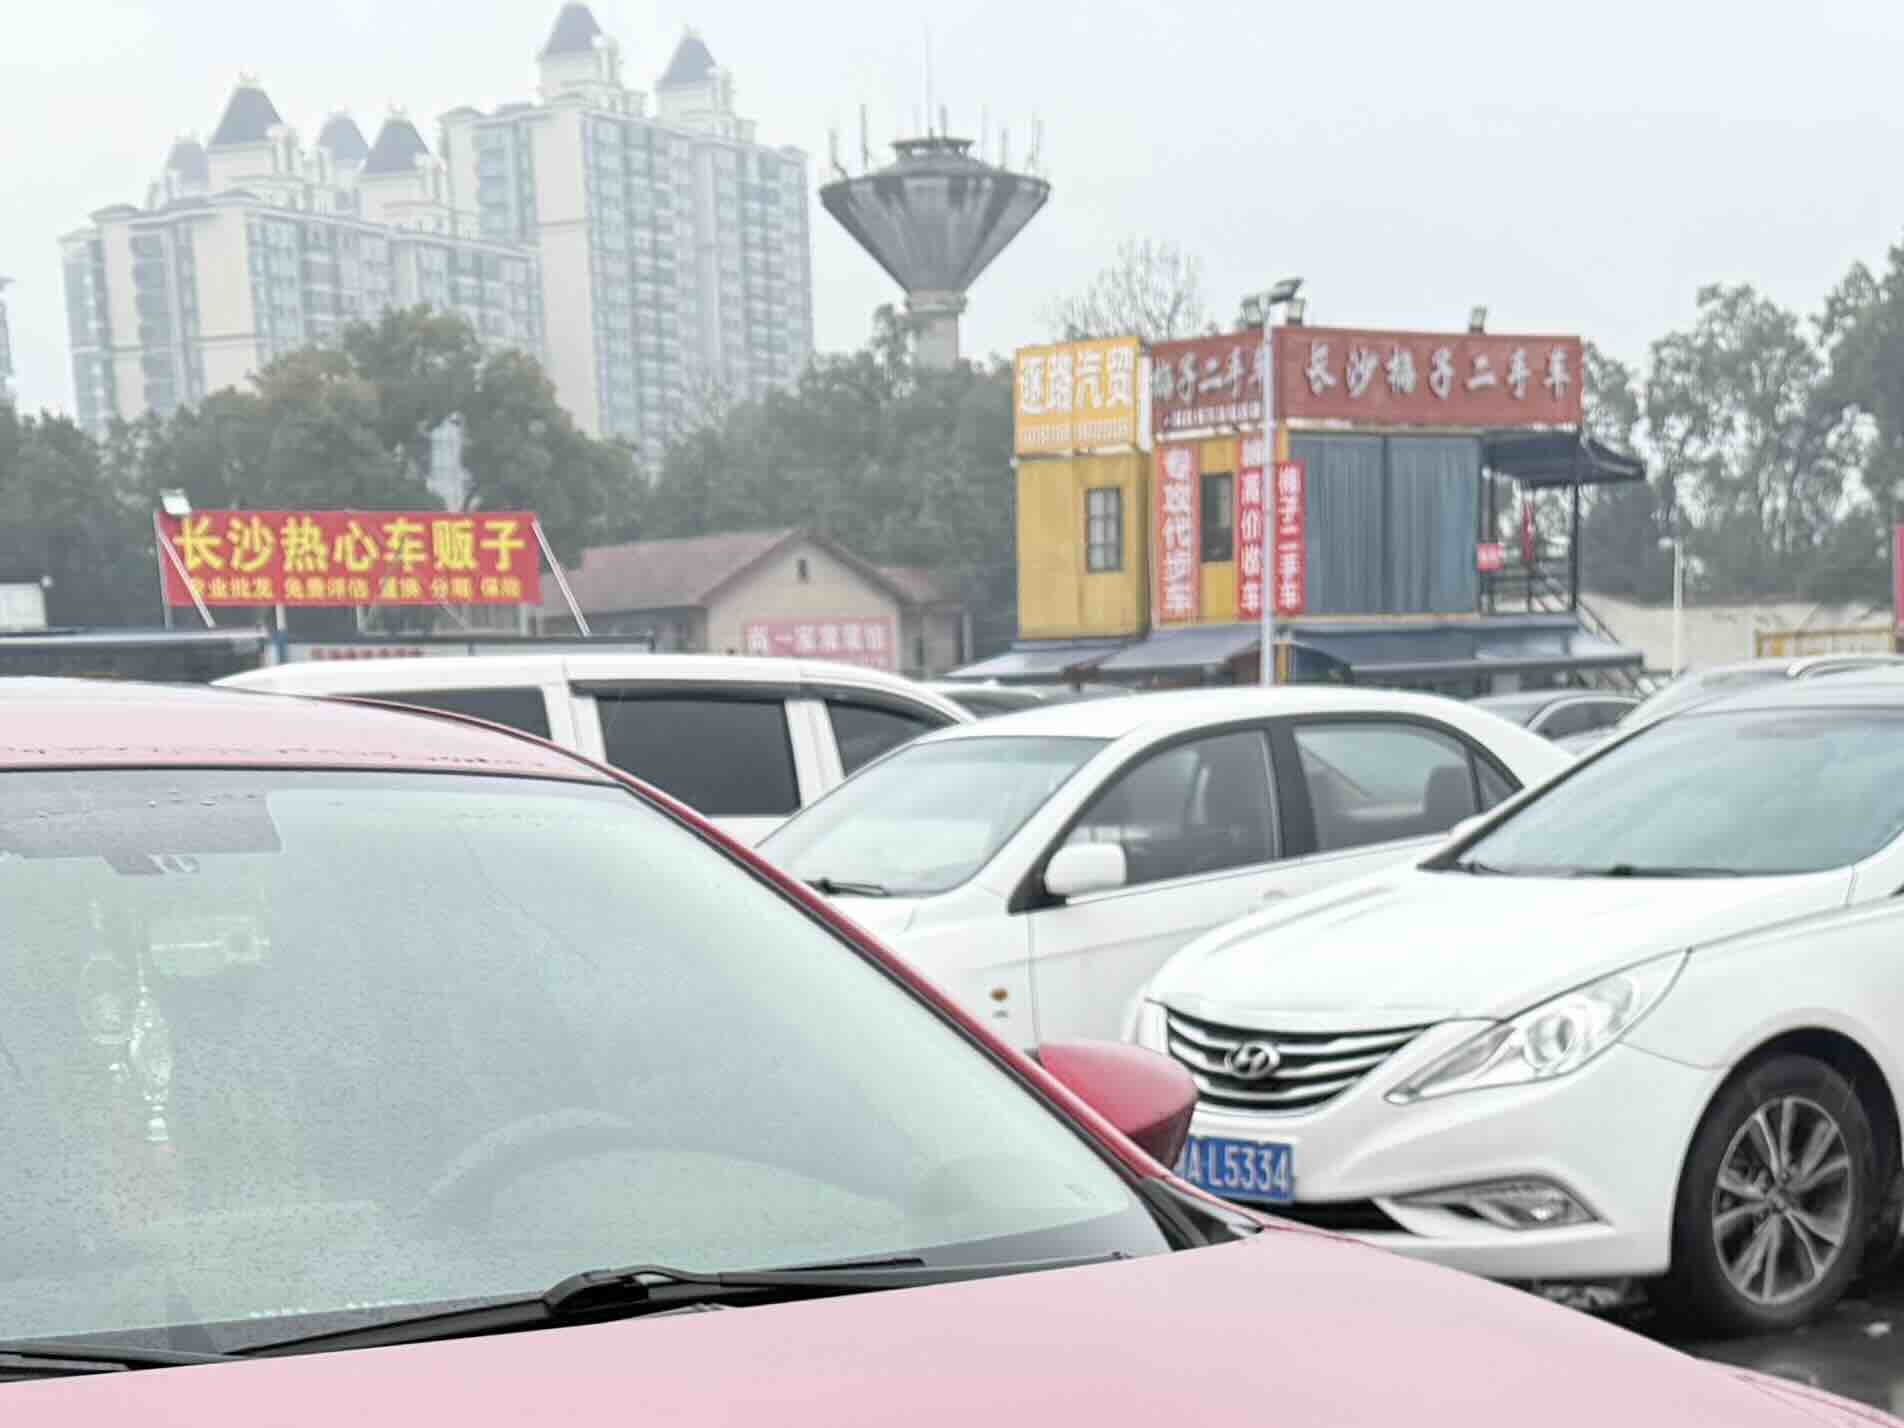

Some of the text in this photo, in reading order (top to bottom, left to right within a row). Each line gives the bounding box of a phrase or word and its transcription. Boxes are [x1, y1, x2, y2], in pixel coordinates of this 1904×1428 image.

[173, 517, 527, 571] 长沙热心车贩子
